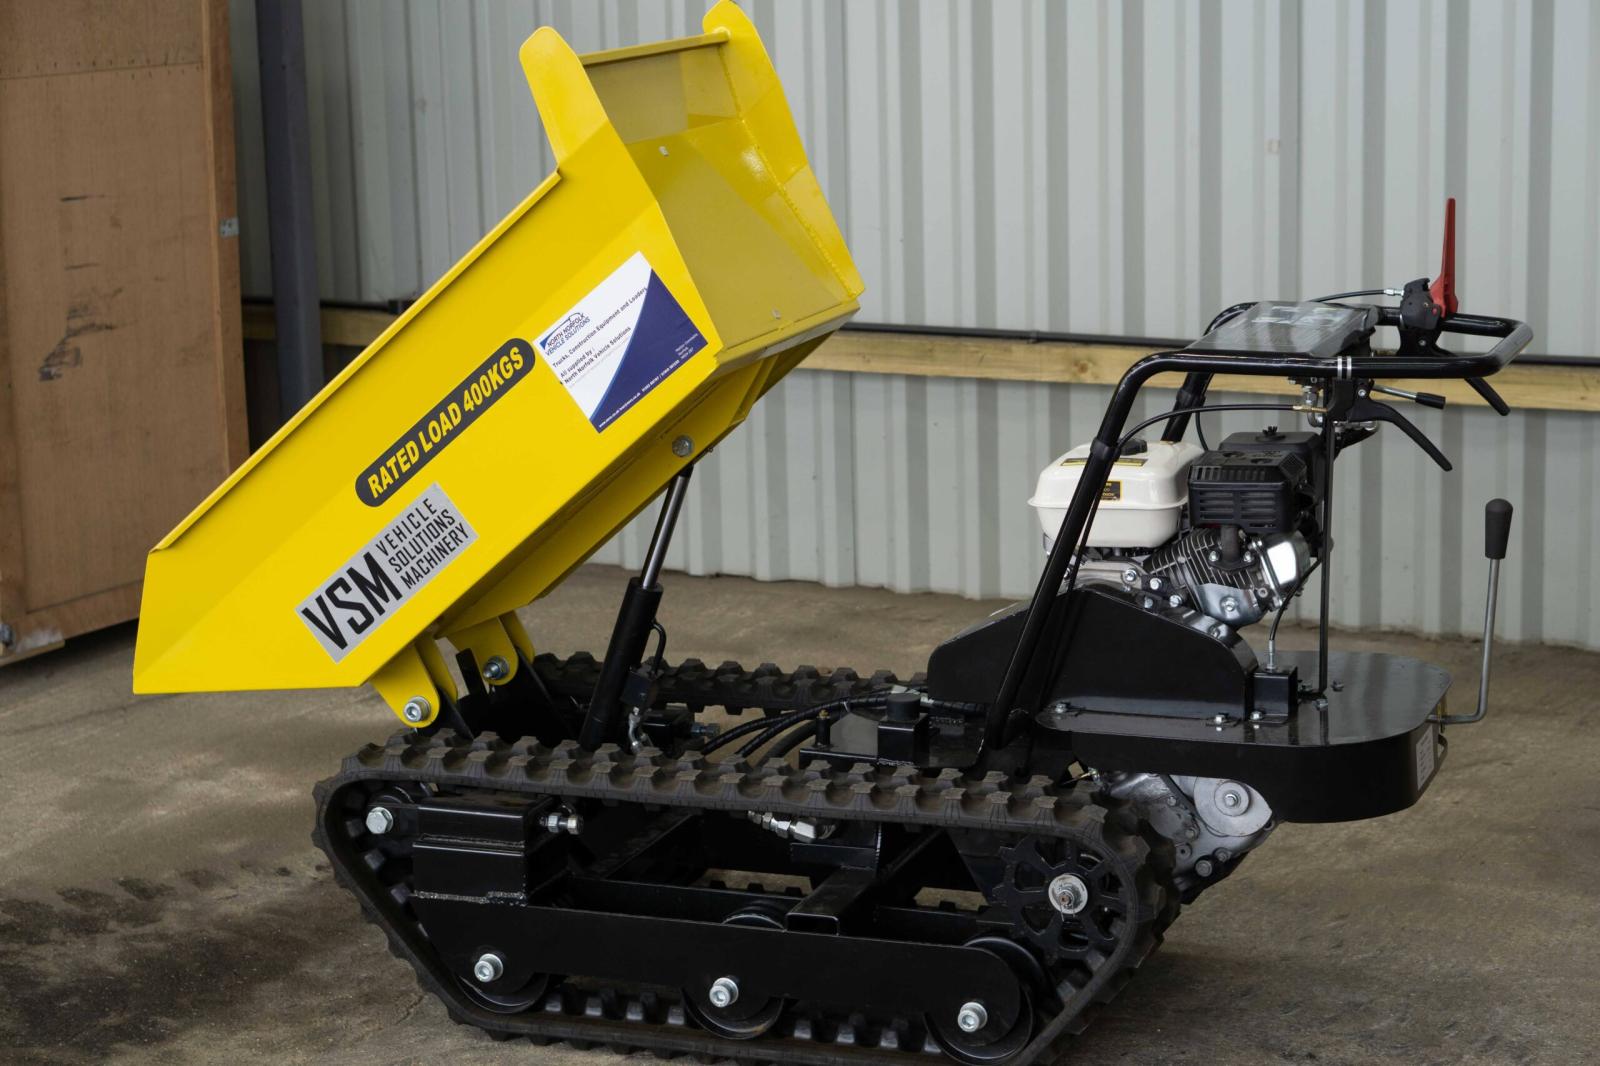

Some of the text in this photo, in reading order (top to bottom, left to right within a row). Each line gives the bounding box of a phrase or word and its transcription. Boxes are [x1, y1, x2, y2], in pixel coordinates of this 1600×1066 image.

[545, 316, 590, 356] VEHICLE SOLUTIONS
[547, 313, 585, 347] NORTH NORFOLK
[552, 352, 570, 368] Trucks,
[568, 329, 597, 355] Construction
[596, 308, 620, 331] Equipment
[620, 301, 629, 312] and
[564, 326, 631, 384] North Norfolk Vehicle Solutions
[560, 370, 568, 379] All
[567, 354, 586, 373] supplied
[585, 348, 593, 358] by
[367, 443, 420, 499] RATED
[420, 403, 462, 452] LOAD
[464, 346, 524, 412] 400KGS
[375, 498, 437, 556] VEHICLE
[388, 509, 455, 573] SOLUTIONS
[400, 523, 469, 589] MACHINERY
[301, 551, 403, 650] VSM
